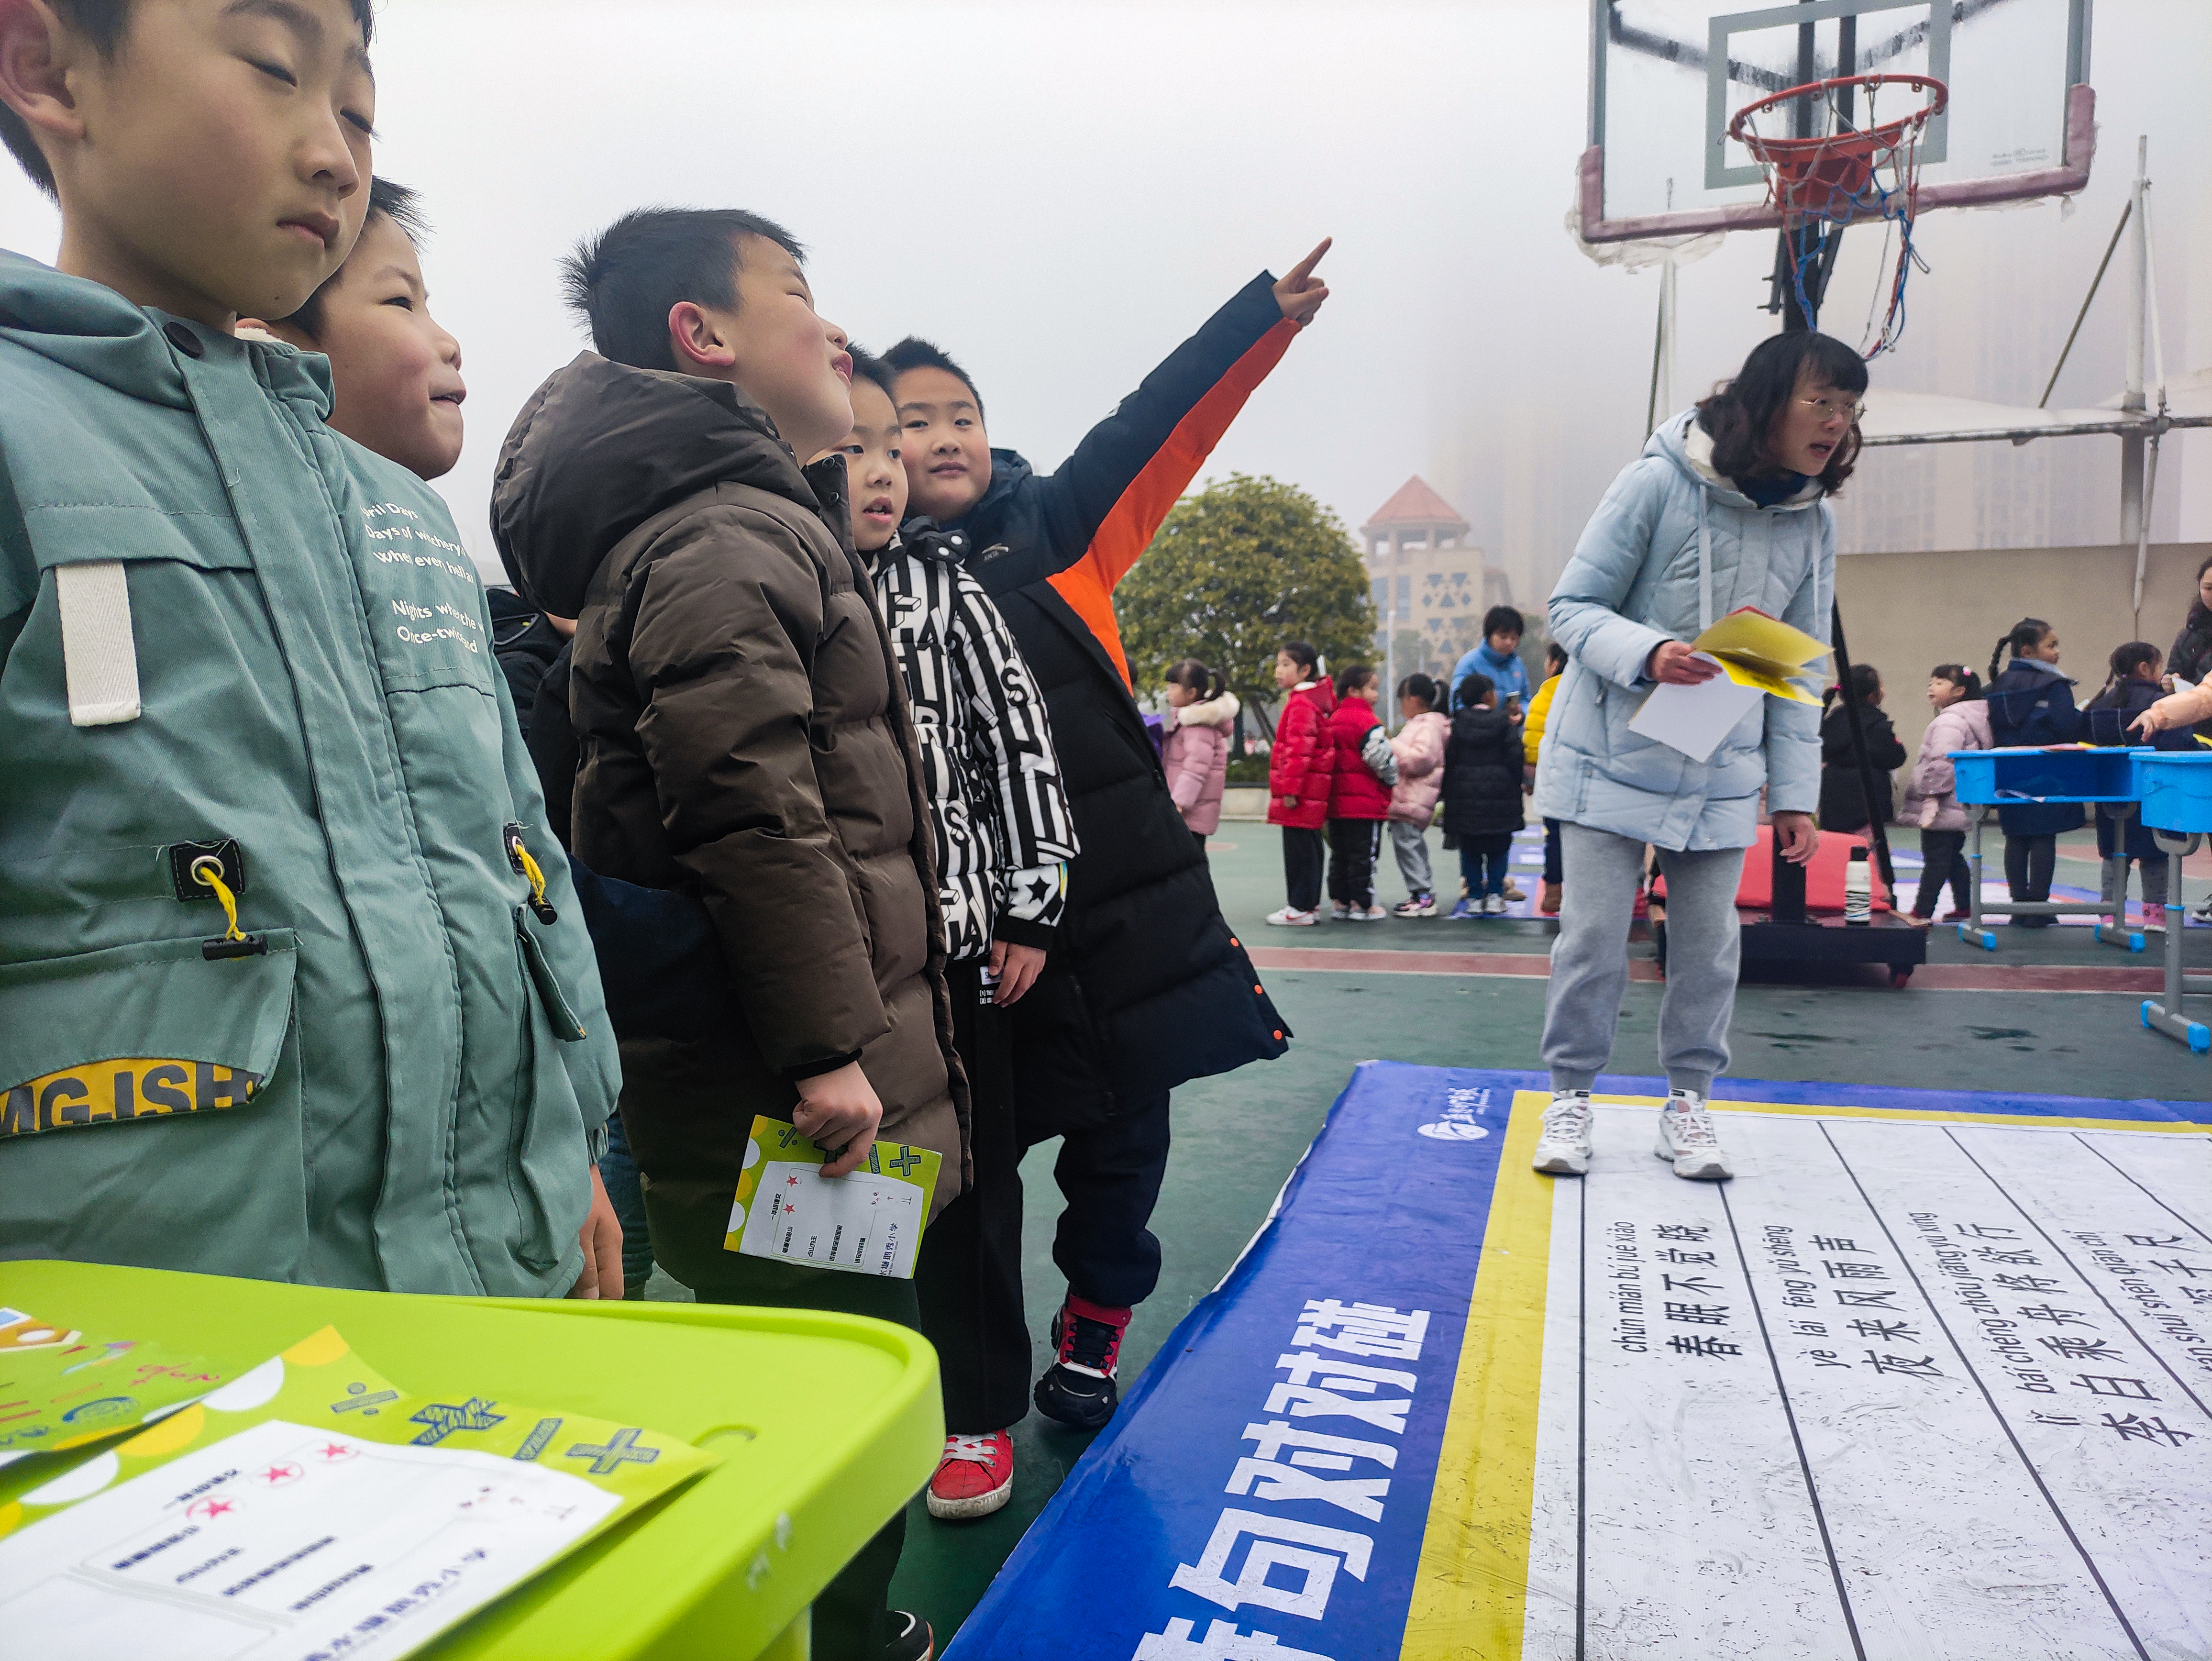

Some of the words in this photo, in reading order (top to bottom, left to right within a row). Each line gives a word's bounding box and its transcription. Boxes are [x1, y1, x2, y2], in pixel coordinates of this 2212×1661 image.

[360, 505, 387, 520] pril
[385, 502, 419, 520] Days
[365, 524, 400, 541] Days
[401, 525, 413, 540] of
[414, 530, 461, 557] witchery
[391, 599, 433, 621] Nights
[1606, 1221, 1637, 1243] xiǎo
[1906, 1211, 1943, 1233] xíng
[1606, 1244, 1647, 1263] jué
[1762, 1224, 1797, 1257] shēng
[1916, 1234, 1962, 1248] yù
[1607, 1264, 1640, 1280] bú
[1934, 1250, 1985, 1282] jiāng
[2090, 1249, 2143, 1275] qiān
[1608, 1283, 1644, 1315] mián
[1651, 1222, 1744, 1361] 春眠不觉晓
[1781, 1278, 1817, 1309] fēng
[1808, 1234, 1945, 1379] 夜来风雨声
[1953, 1282, 2001, 1315] zhōu
[2119, 1278, 2172, 1309] shēn
[1611, 1318, 1648, 1353] chūn
[1788, 1319, 1830, 1338] lái
[1954, 1221, 2196, 1448] 李白乘舟将欲行
[1979, 1318, 2035, 1363] chéng
[1796, 1348, 1852, 1369] yè
[2001, 1365, 2058, 1394] bái
